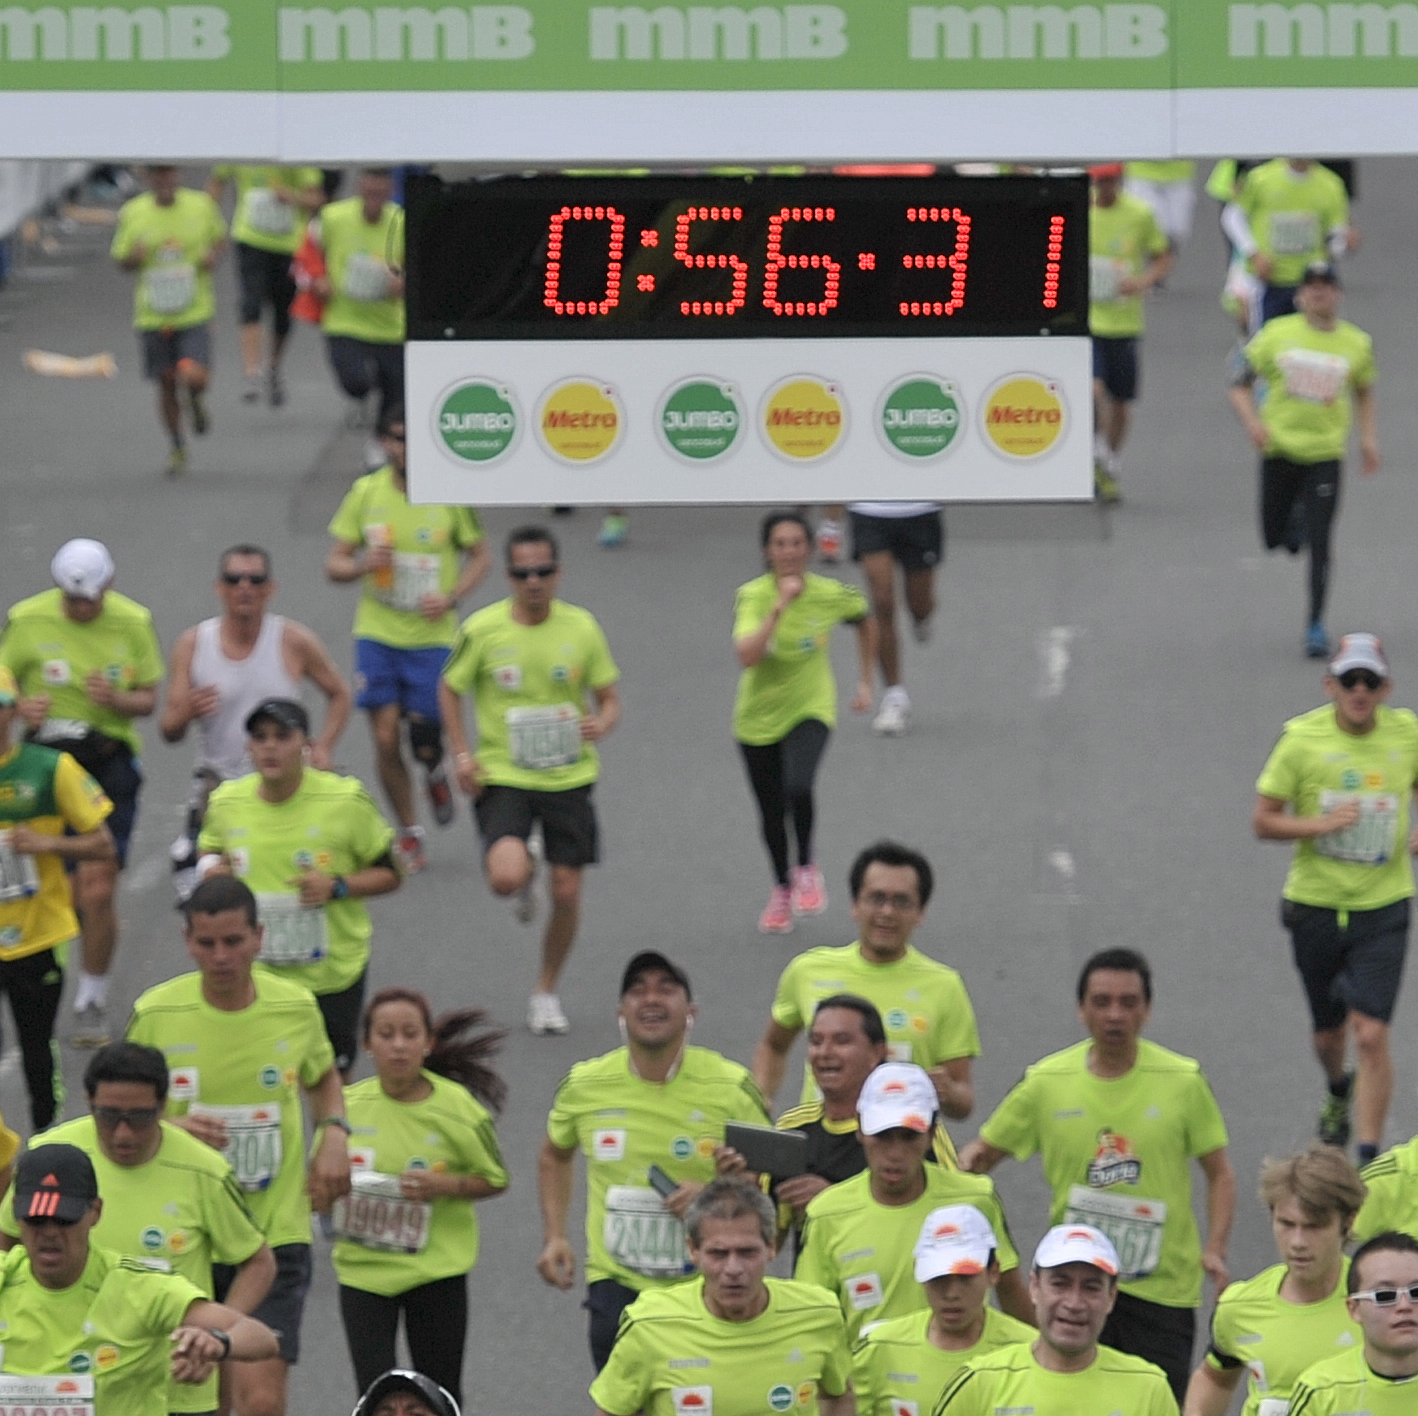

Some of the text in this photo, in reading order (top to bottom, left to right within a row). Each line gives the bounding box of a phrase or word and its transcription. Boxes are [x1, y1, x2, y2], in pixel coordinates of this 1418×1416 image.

[439, 412, 516, 432] JUMBO
[543, 410, 617, 430] Metro
[663, 411, 740, 431] JUMBO
[766, 408, 841, 428] Metro
[884, 408, 959, 429] JUMBO
[987, 406, 1062, 425] Metro
